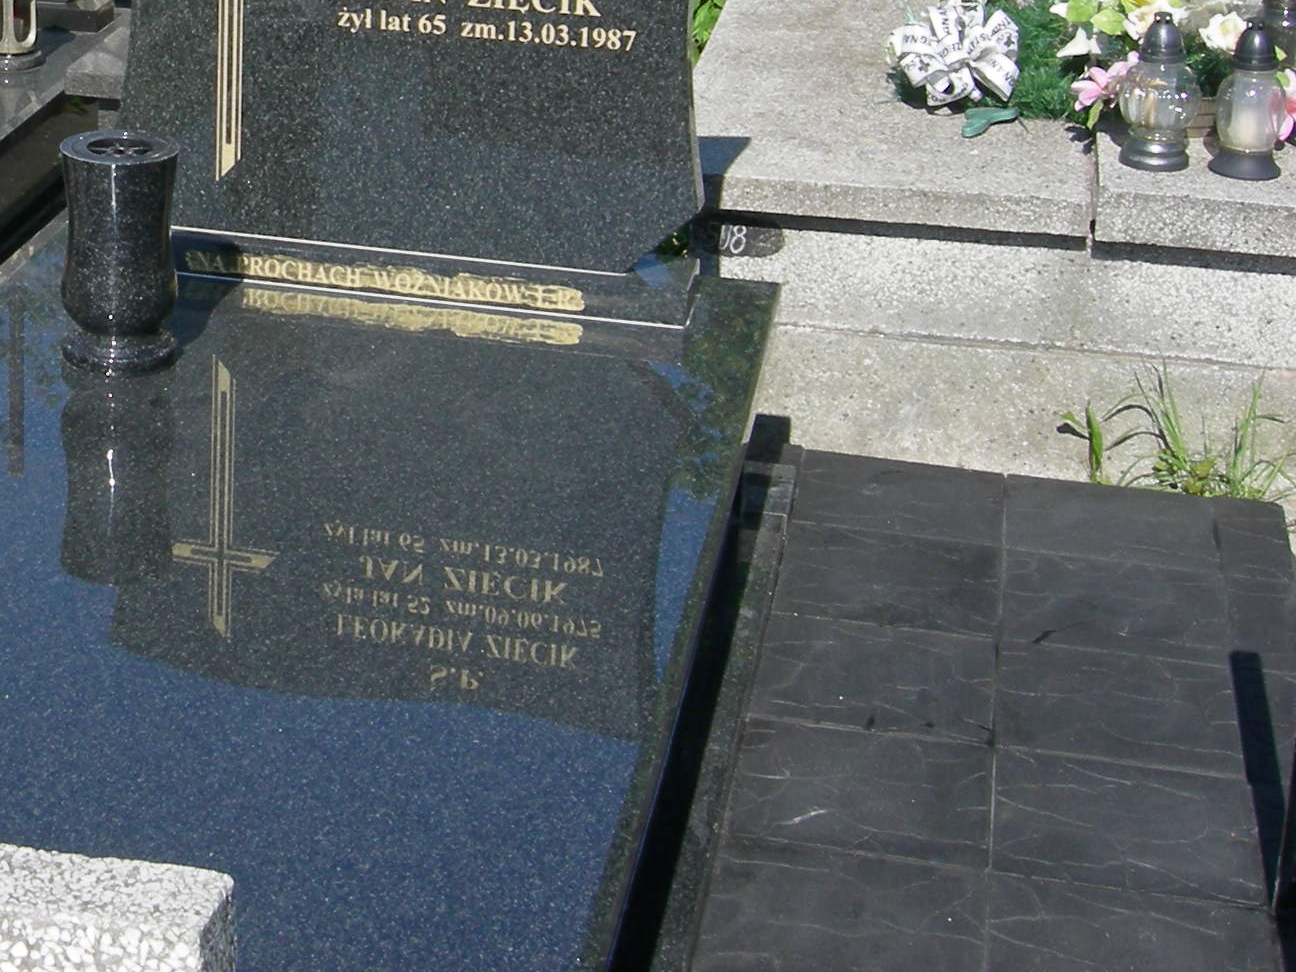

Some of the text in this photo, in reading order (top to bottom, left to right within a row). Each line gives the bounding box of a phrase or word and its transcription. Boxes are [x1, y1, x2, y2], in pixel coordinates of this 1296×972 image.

[337, 6, 637, 53] żył lat 65 zm.13.03.1987
[239, 255, 361, 289] PROCHACH
